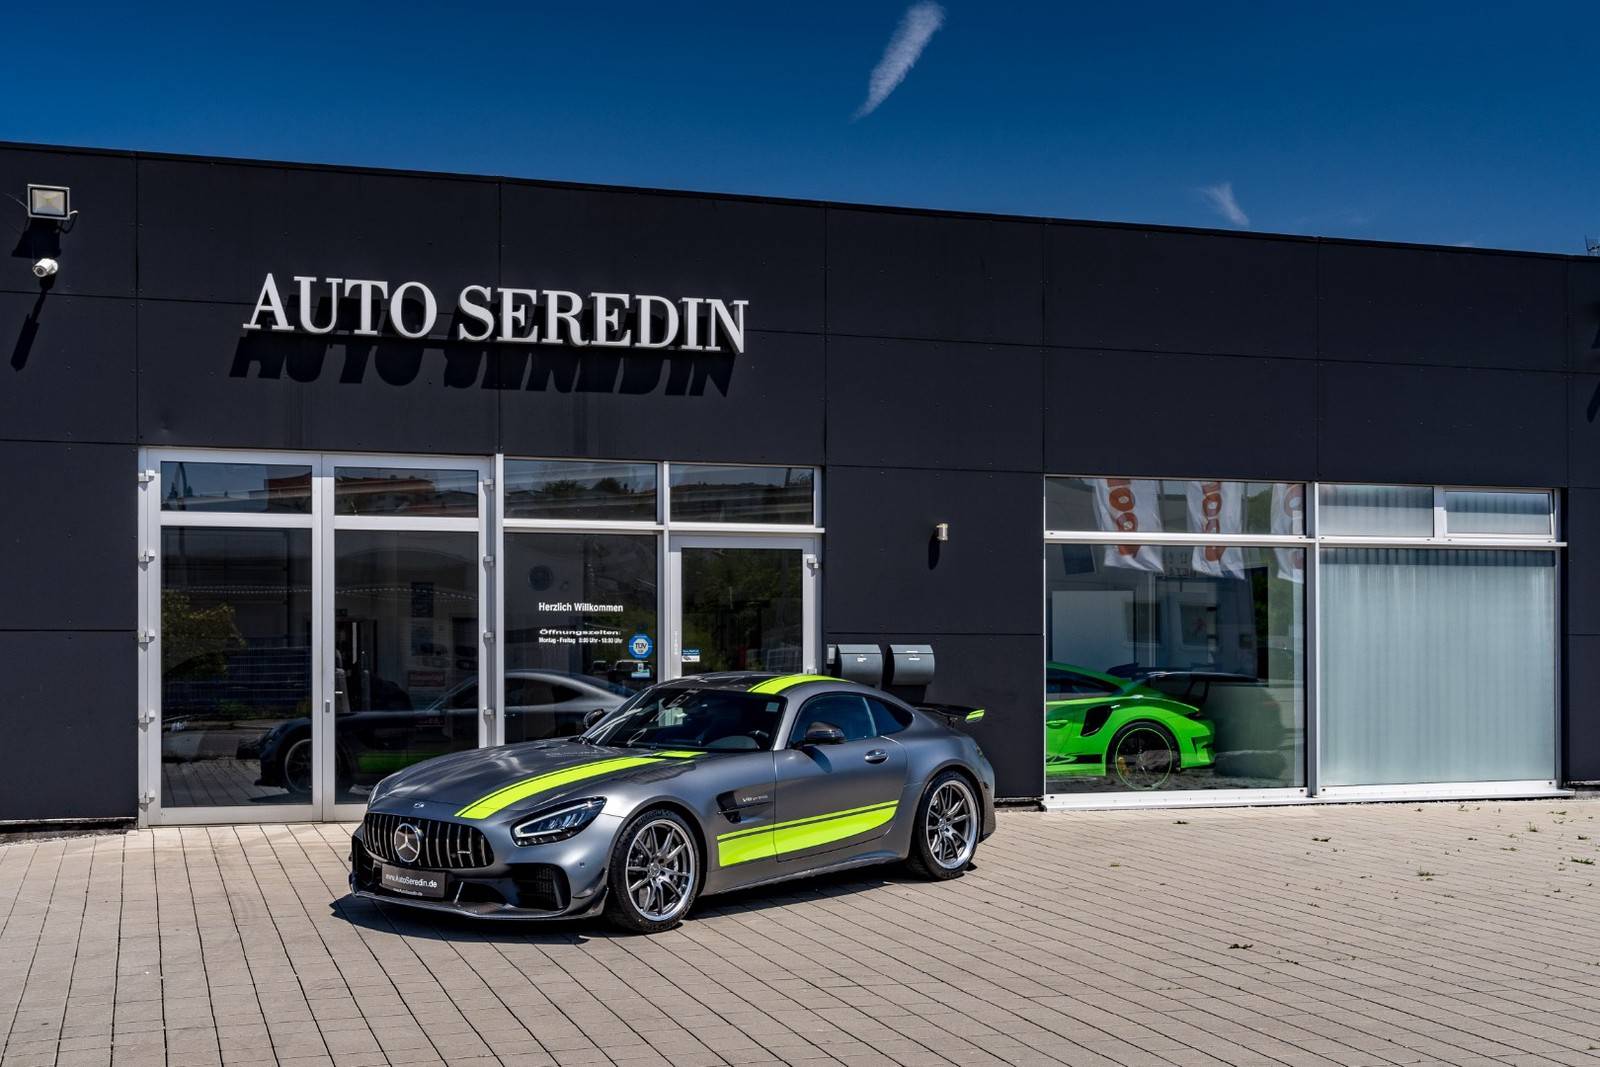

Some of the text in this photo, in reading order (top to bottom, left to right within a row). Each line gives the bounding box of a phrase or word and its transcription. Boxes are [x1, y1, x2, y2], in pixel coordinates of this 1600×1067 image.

[242, 272, 749, 354] AUTO SEREDIN
[538, 602, 624, 613] Herzlich Willkommen
[634, 642, 648, 650] TÜV
